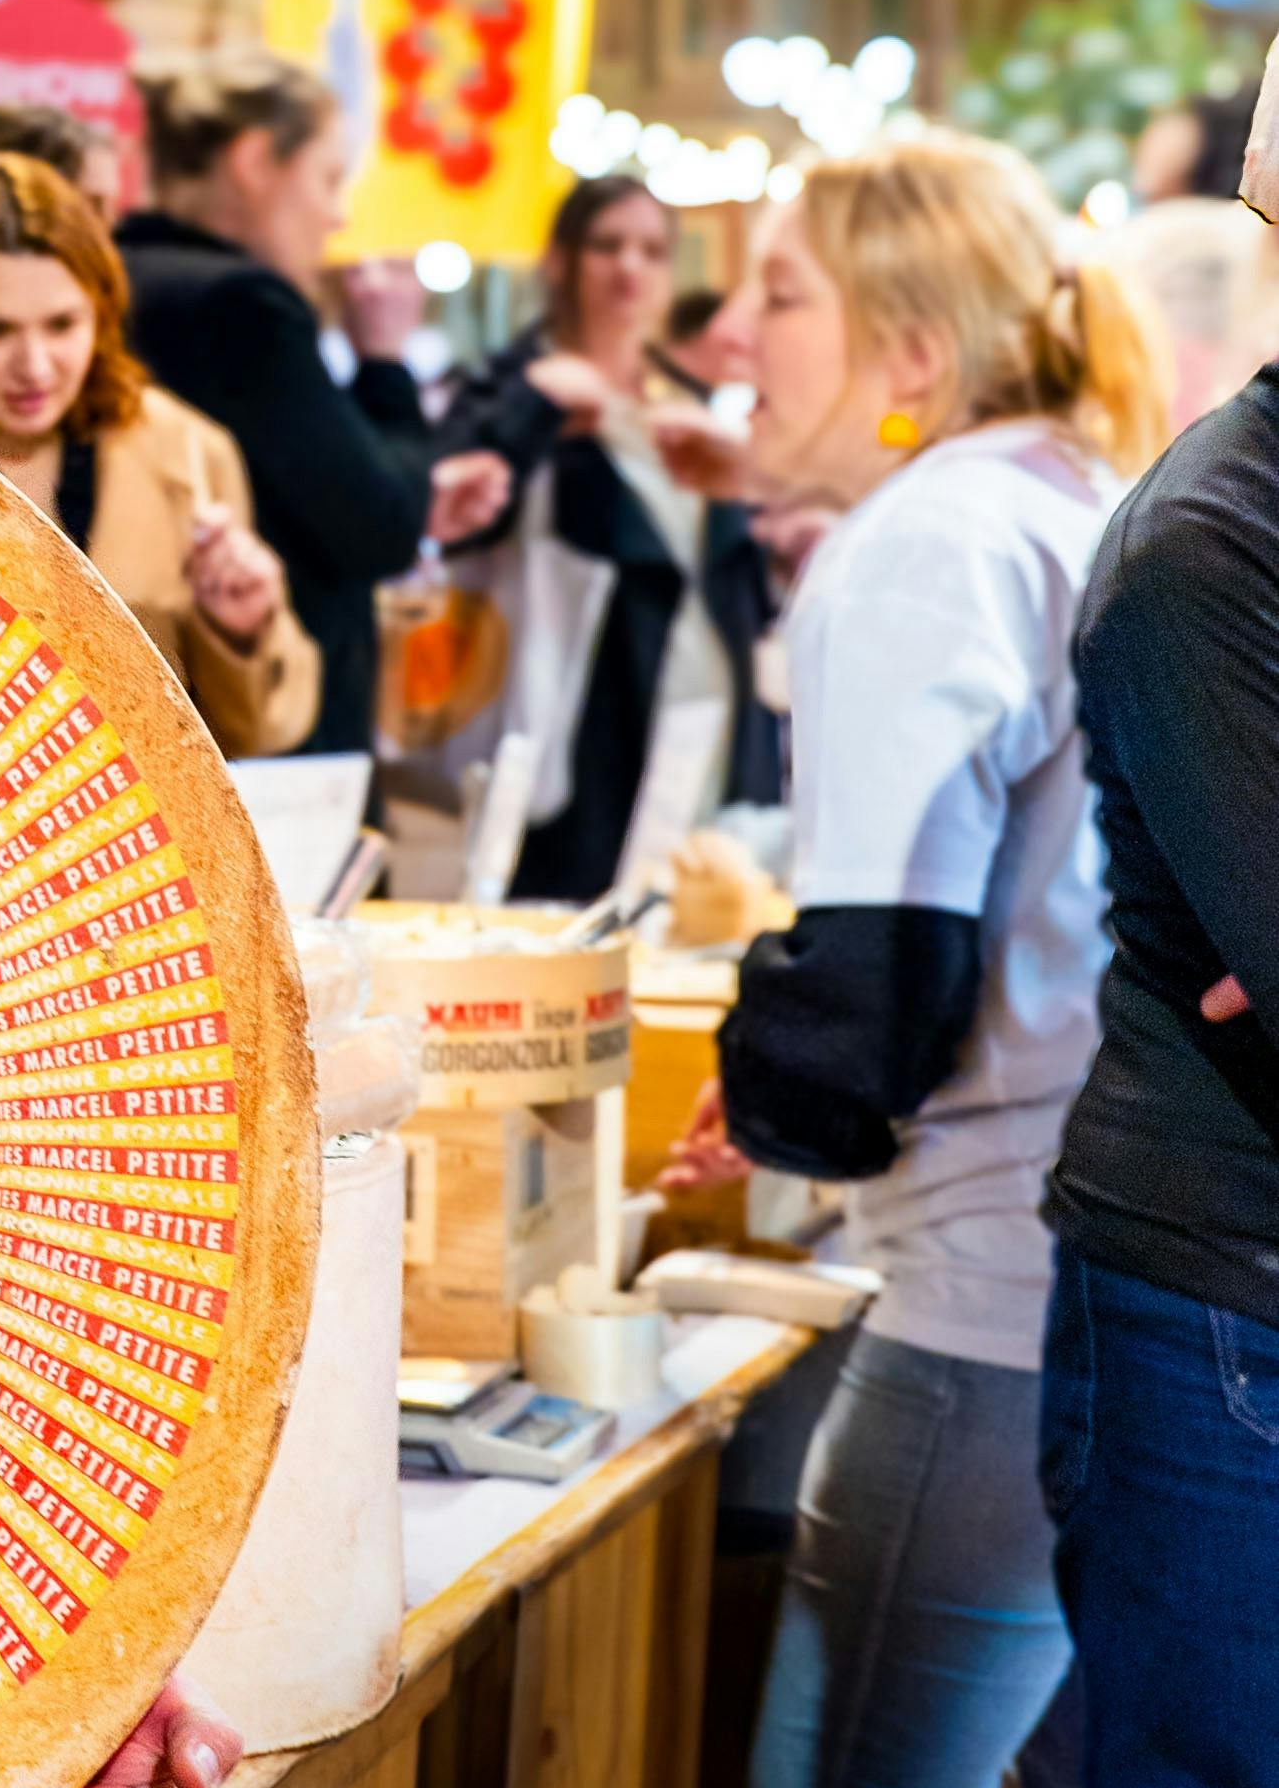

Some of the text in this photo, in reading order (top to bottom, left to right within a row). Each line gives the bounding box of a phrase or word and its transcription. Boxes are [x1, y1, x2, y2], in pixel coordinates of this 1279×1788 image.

[4, 705, 94, 792] PETITE
[36, 761, 129, 840] PETITE
[63, 821, 160, 891] PETITE
[87, 883, 184, 945] PETITE
[12, 983, 97, 1026] MARCEL
[104, 948, 203, 1000] PETITE
[22, 1037, 108, 1071] MARCEL
[117, 1015, 217, 1058] PETITE
[421, 1037, 574, 1074] GORGONZOLA
[28, 1093, 113, 1119] MARCEL
[125, 1084, 224, 1117] PETITE
[30, 1146, 114, 1172] MARCEL
[127, 1149, 225, 1180] PETITE
[26, 1193, 112, 1227] MARCEL
[122, 1209, 222, 1248] PETITE
[18, 1240, 104, 1283] MARCEL
[112, 1267, 213, 1318] PETITE
